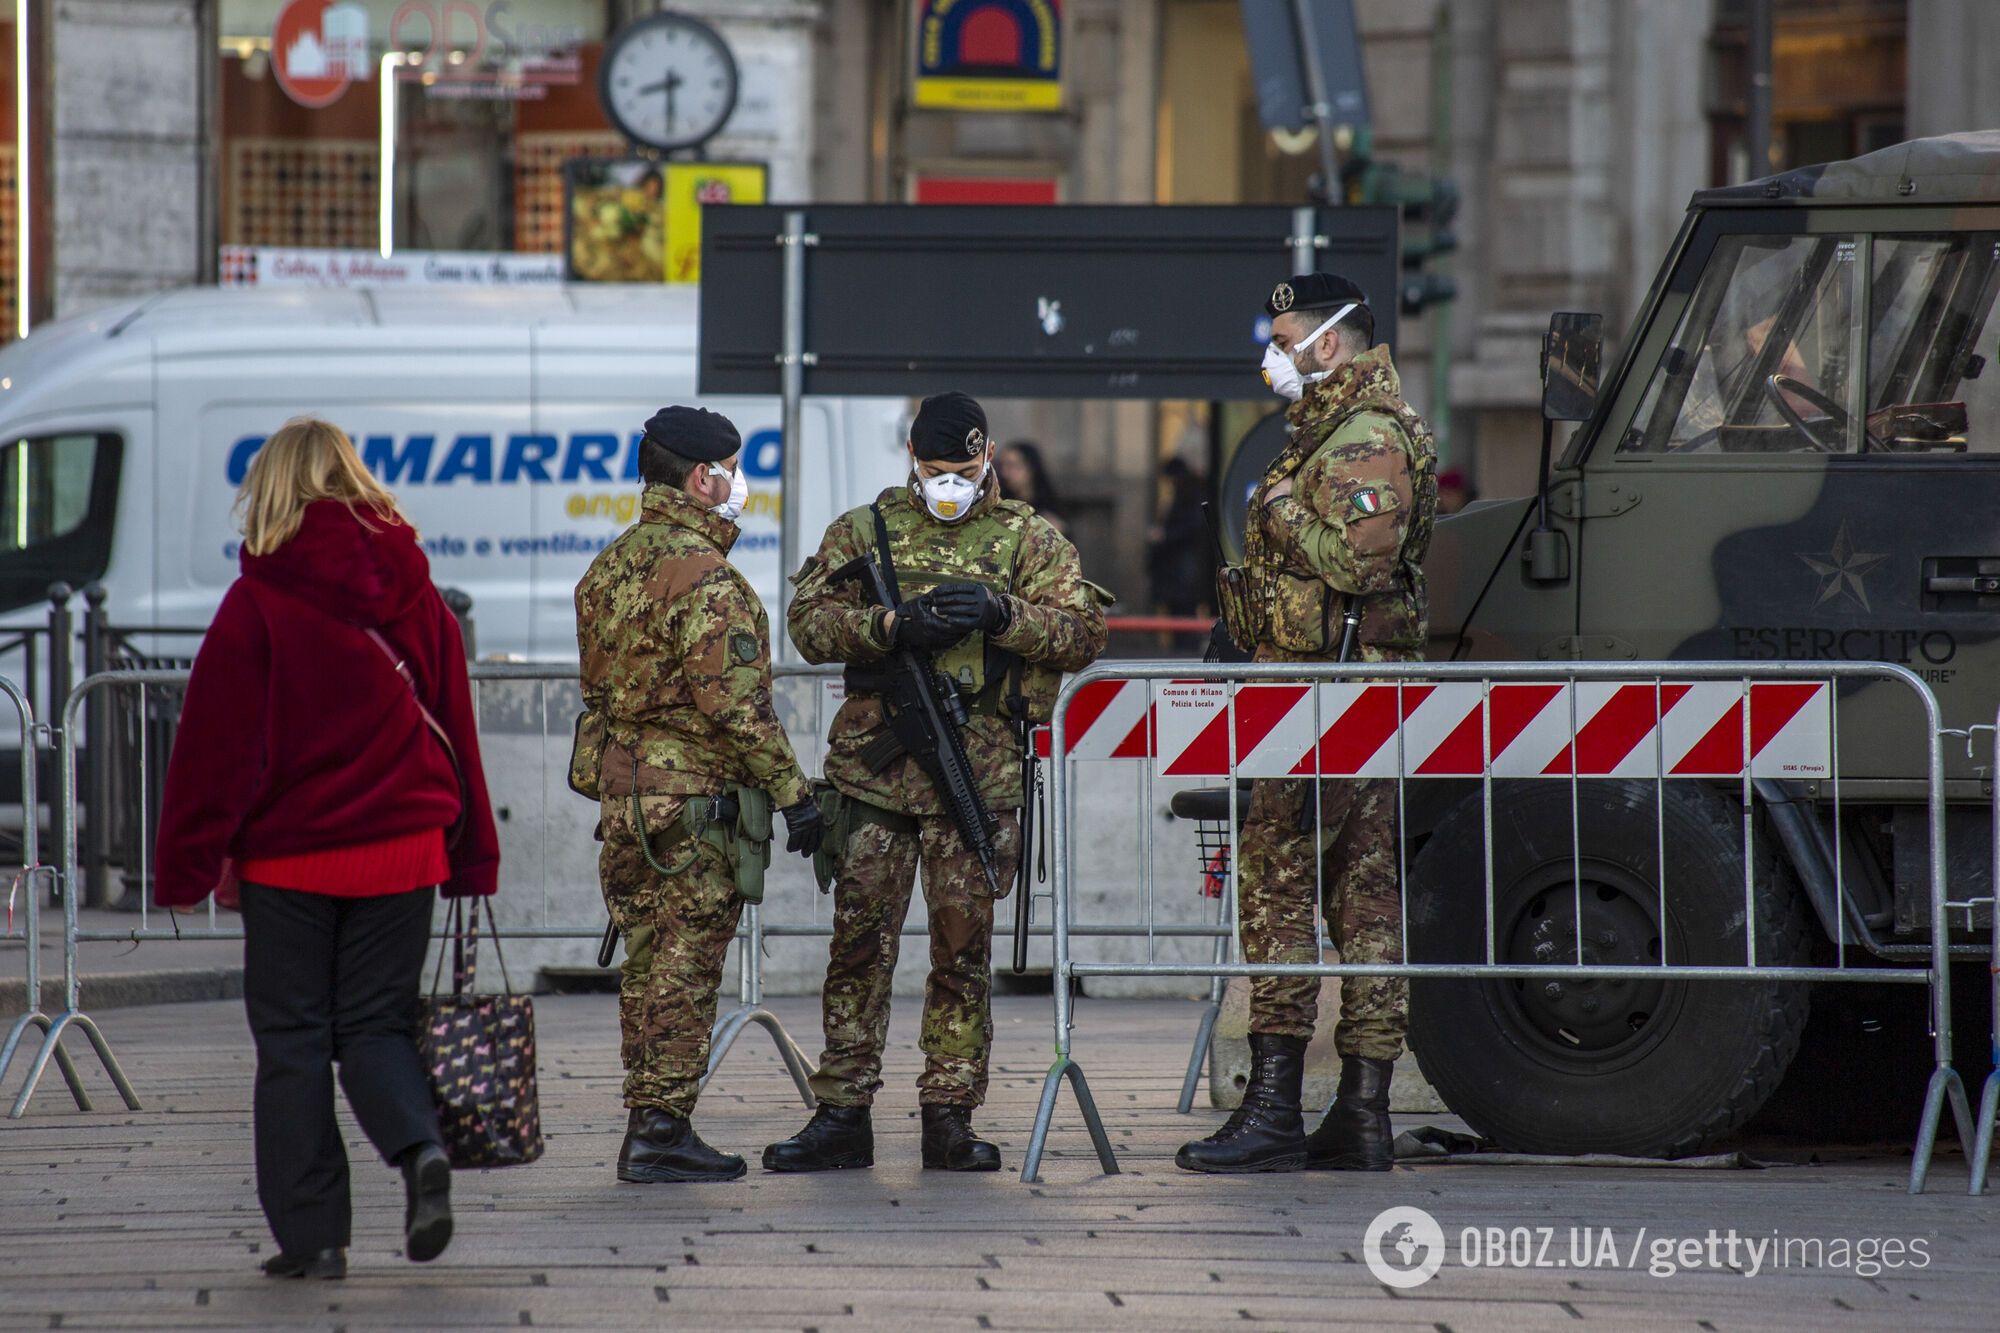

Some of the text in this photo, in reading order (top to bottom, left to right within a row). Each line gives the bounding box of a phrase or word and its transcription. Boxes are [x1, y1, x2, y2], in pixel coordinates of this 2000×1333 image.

[1353, 489, 1374, 499] ITALIA
[1730, 627, 1957, 664] ESERCITO
[1163, 688, 1223, 696] Comune di Milano
